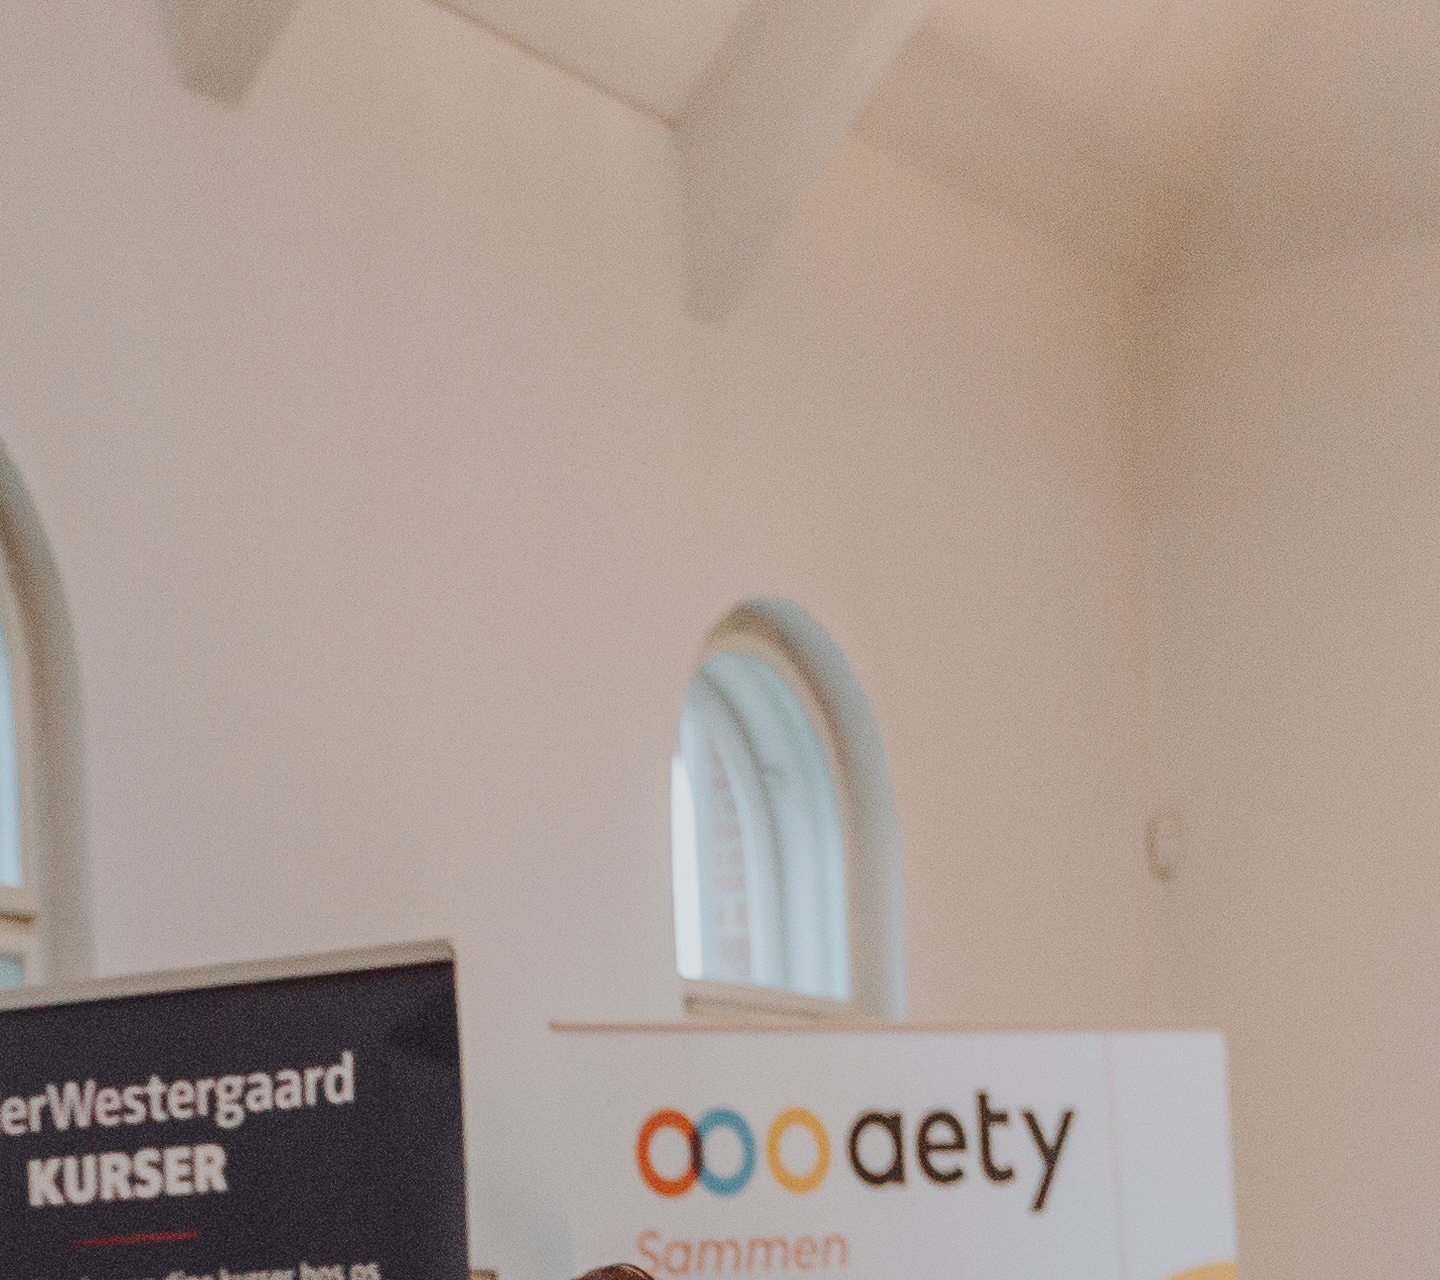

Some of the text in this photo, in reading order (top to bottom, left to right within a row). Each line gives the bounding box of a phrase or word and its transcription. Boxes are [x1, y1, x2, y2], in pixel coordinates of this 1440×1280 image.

[26, 1143, 227, 1207] KURSER
[848, 1090, 1074, 1212] aety
[636, 1229, 849, 1277] Sammen
